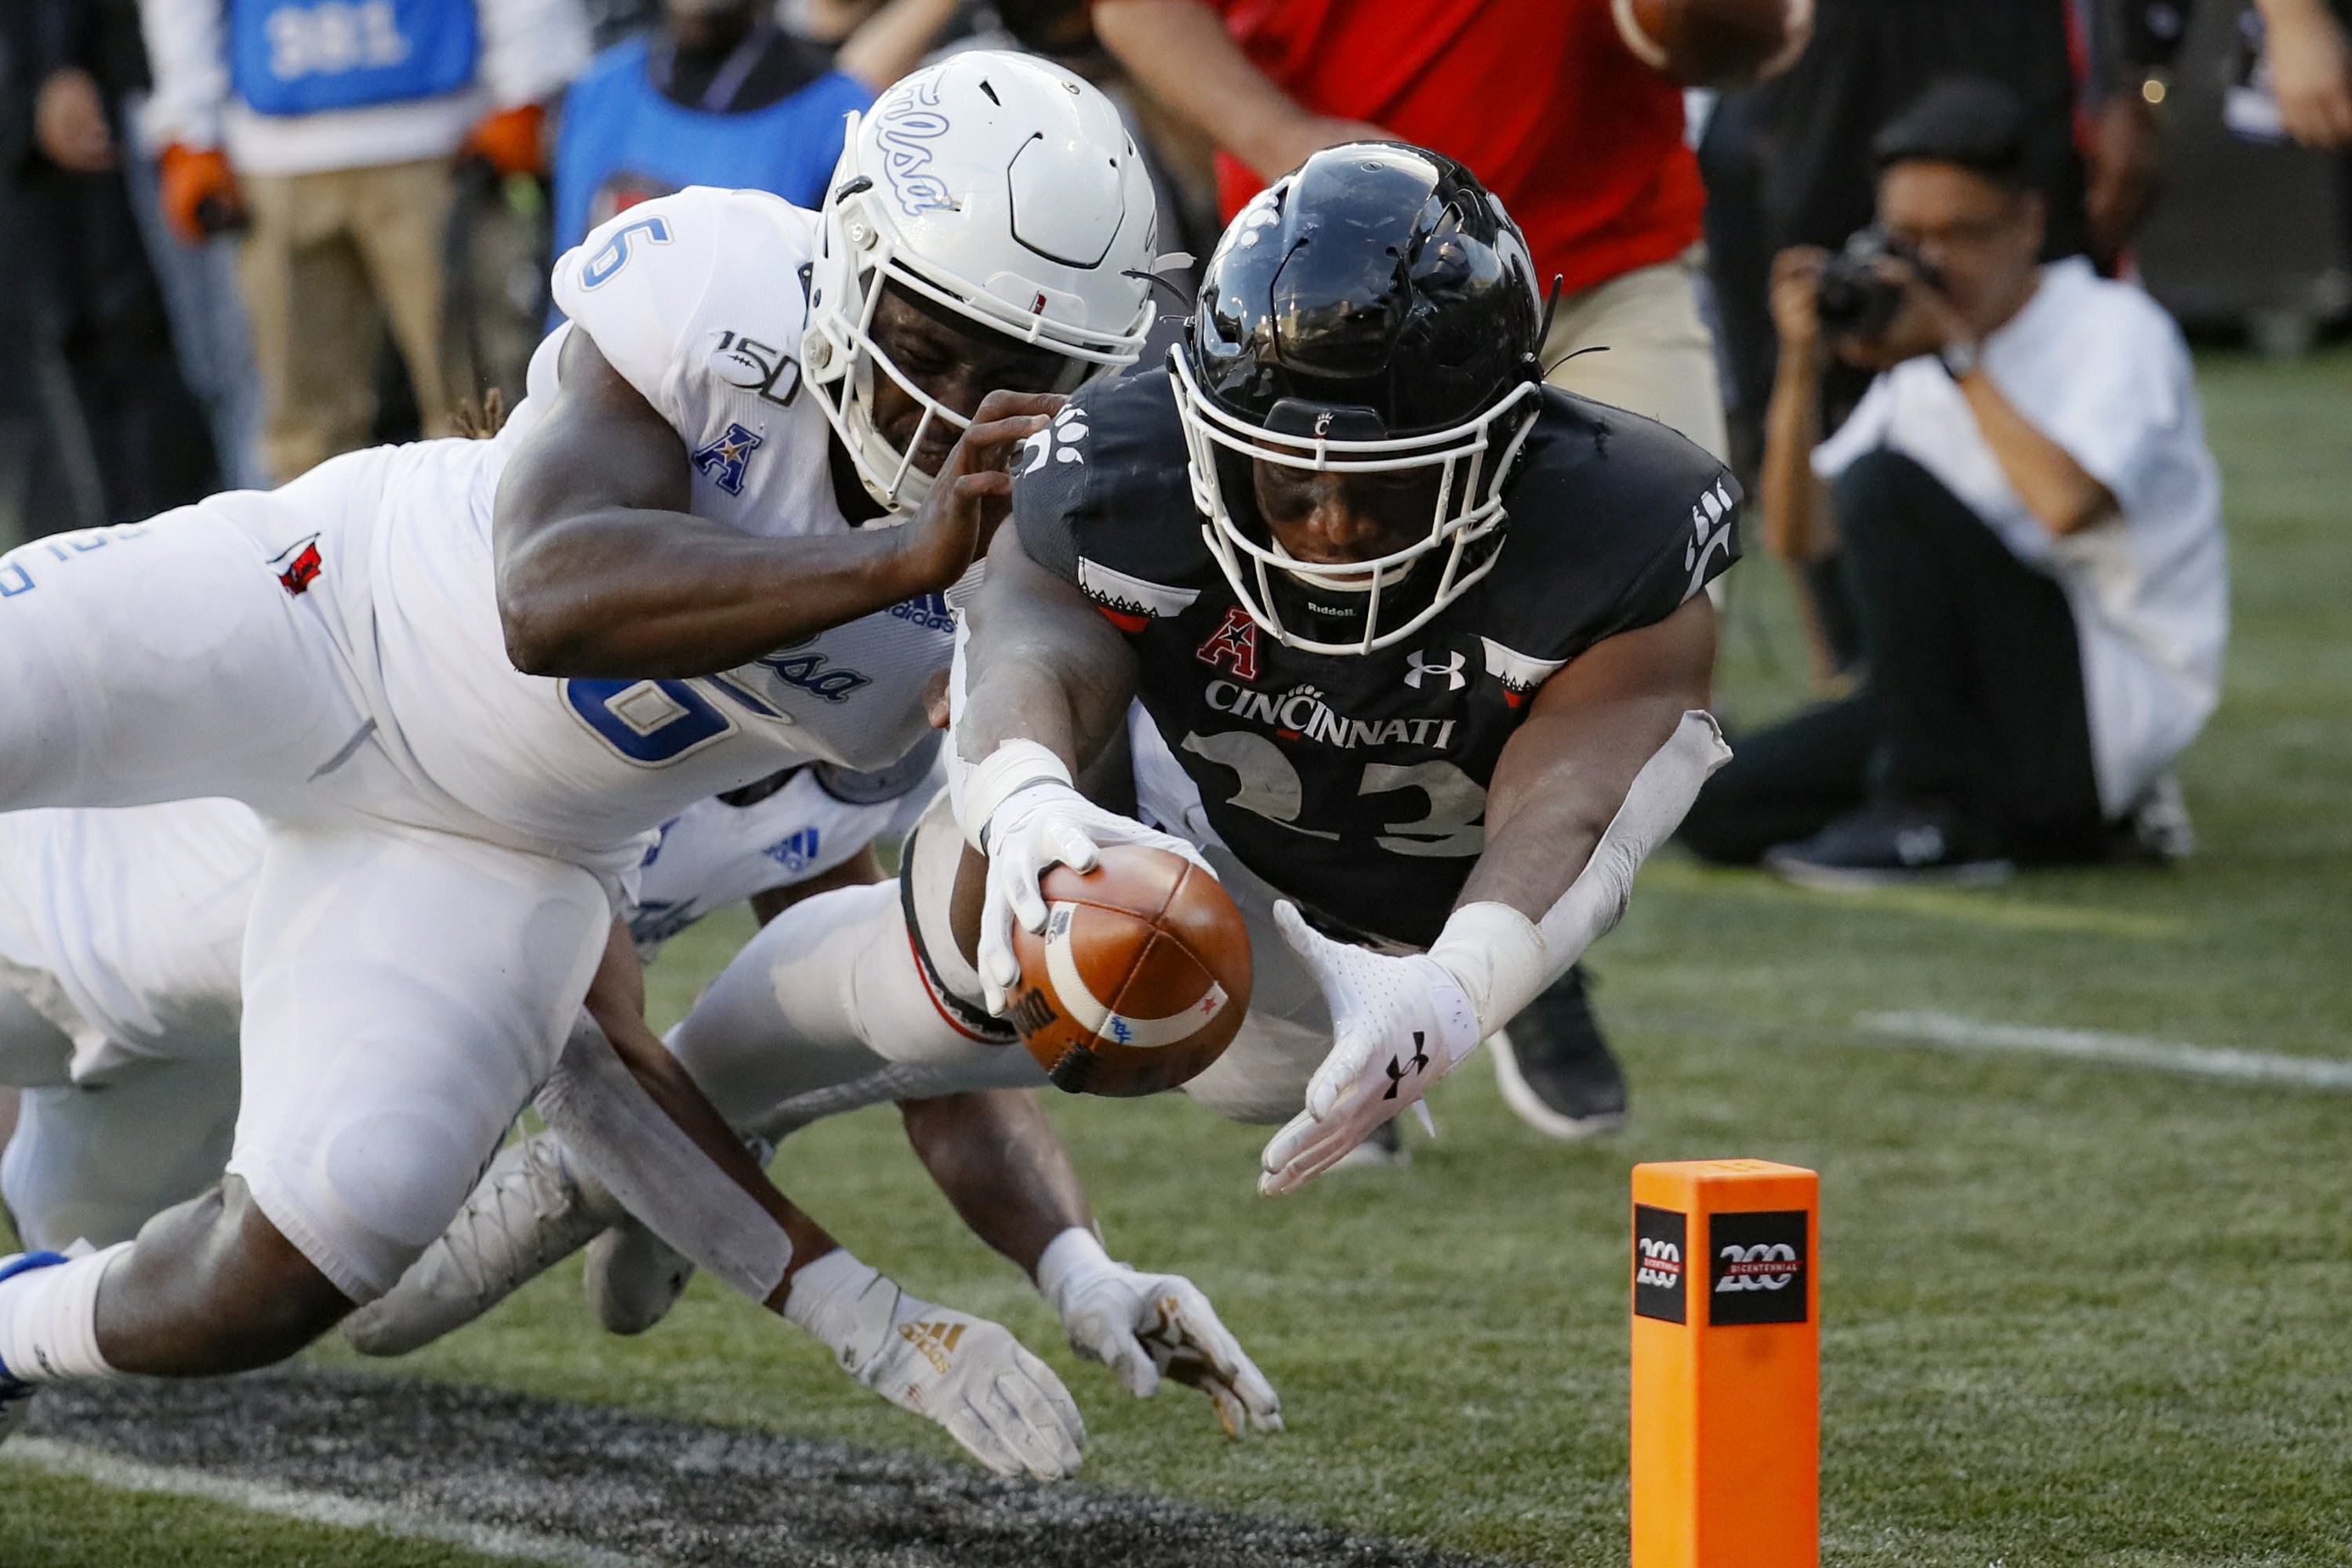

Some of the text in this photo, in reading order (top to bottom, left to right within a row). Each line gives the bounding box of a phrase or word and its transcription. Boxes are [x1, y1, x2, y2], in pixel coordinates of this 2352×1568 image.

[578, 214, 675, 292] 6
[709, 328, 802, 408] 150
[691, 422, 762, 497] A
[1204, 679, 1457, 750] CINCINNATI
[1180, 730, 1491, 858] 23
[1637, 1237, 1680, 1289] 200
[1715, 1243, 1796, 1292] 200
